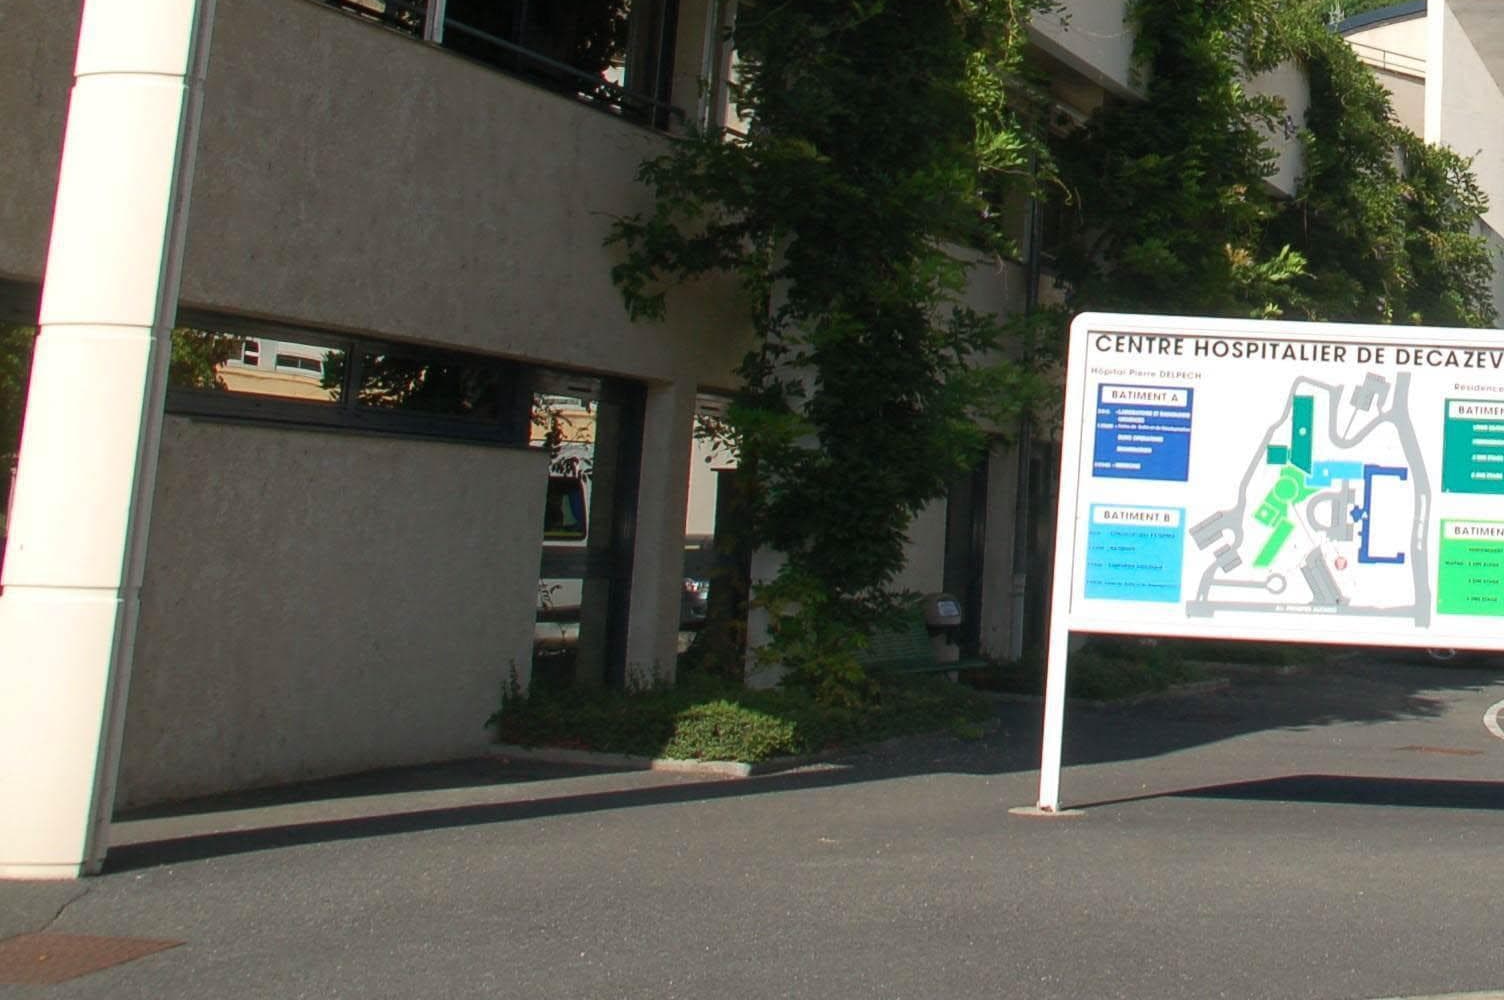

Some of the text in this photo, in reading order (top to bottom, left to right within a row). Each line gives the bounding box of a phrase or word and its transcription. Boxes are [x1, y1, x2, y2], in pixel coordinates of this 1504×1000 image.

[1095, 334, 1184, 356] CENTRE
[1194, 340, 1346, 363] HOSPITALIER
[1357, 346, 1385, 364] DE
[1171, 393, 1179, 402] A
[1103, 509, 1171, 522] BATIMENT B
